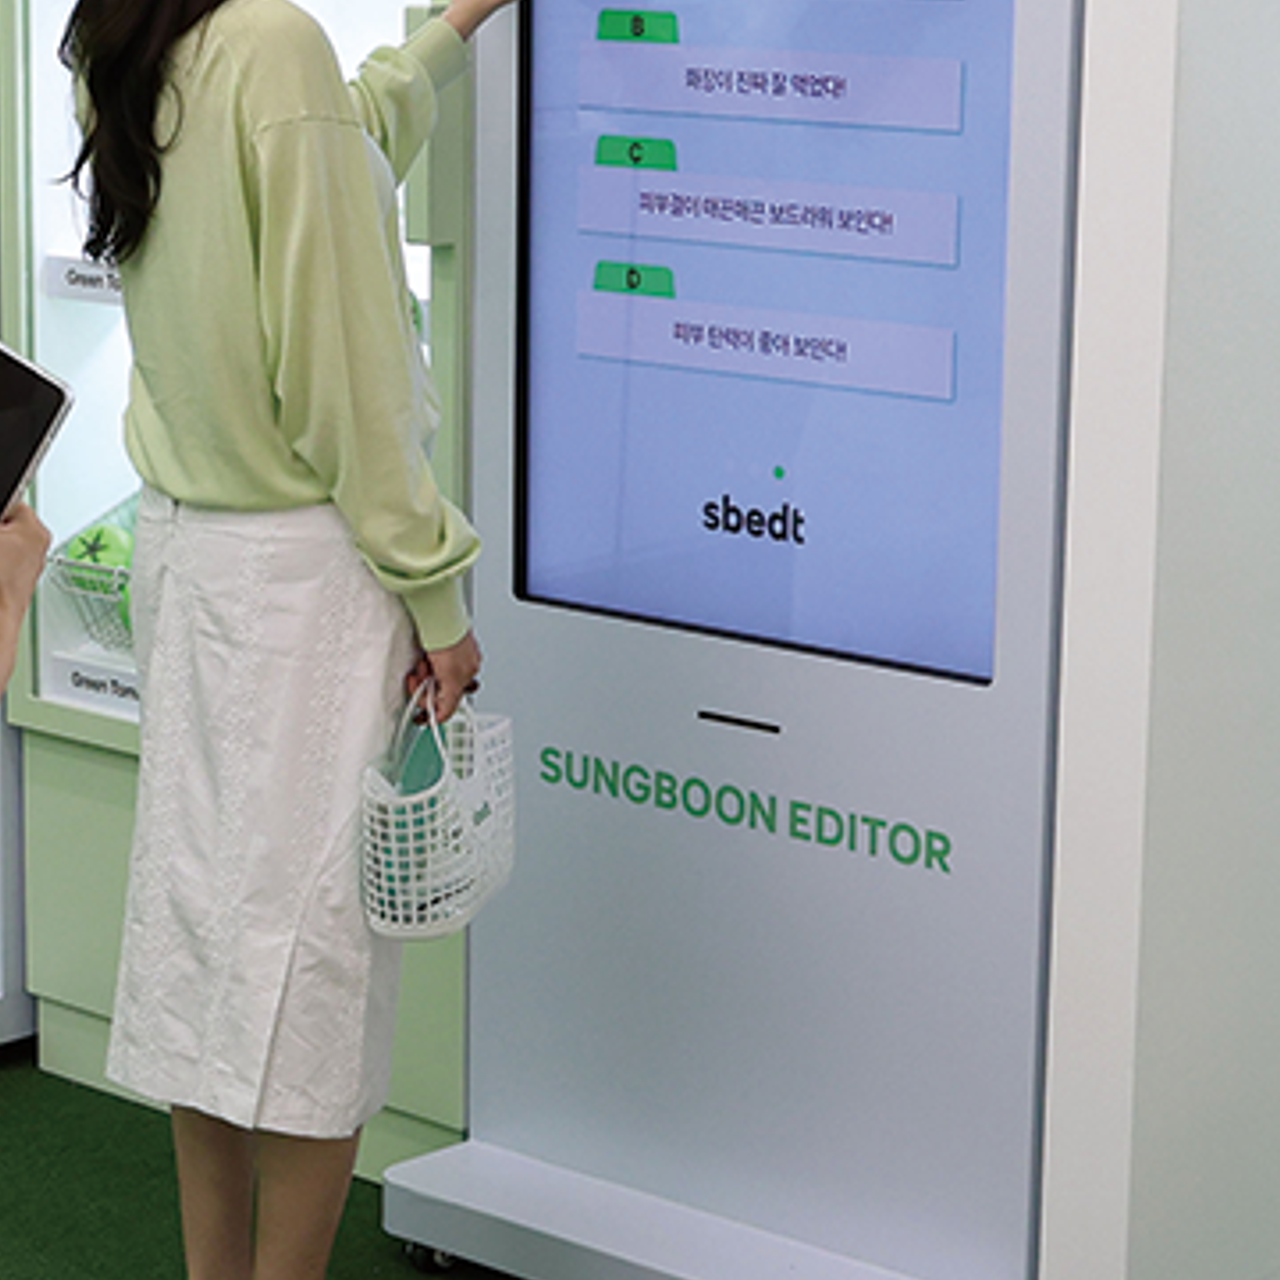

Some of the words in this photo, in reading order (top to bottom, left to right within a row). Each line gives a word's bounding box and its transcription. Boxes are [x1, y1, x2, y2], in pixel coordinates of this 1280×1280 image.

[631, 16, 646, 37] B
[628, 142, 644, 163] C
[65, 267, 104, 289] Green
[627, 269, 641, 290] D
[702, 494, 807, 545] sbedt
[71, 671, 108, 695] Green
[538, 746, 778, 835] SUNGBOON
[787, 800, 952, 875] EDITOR
